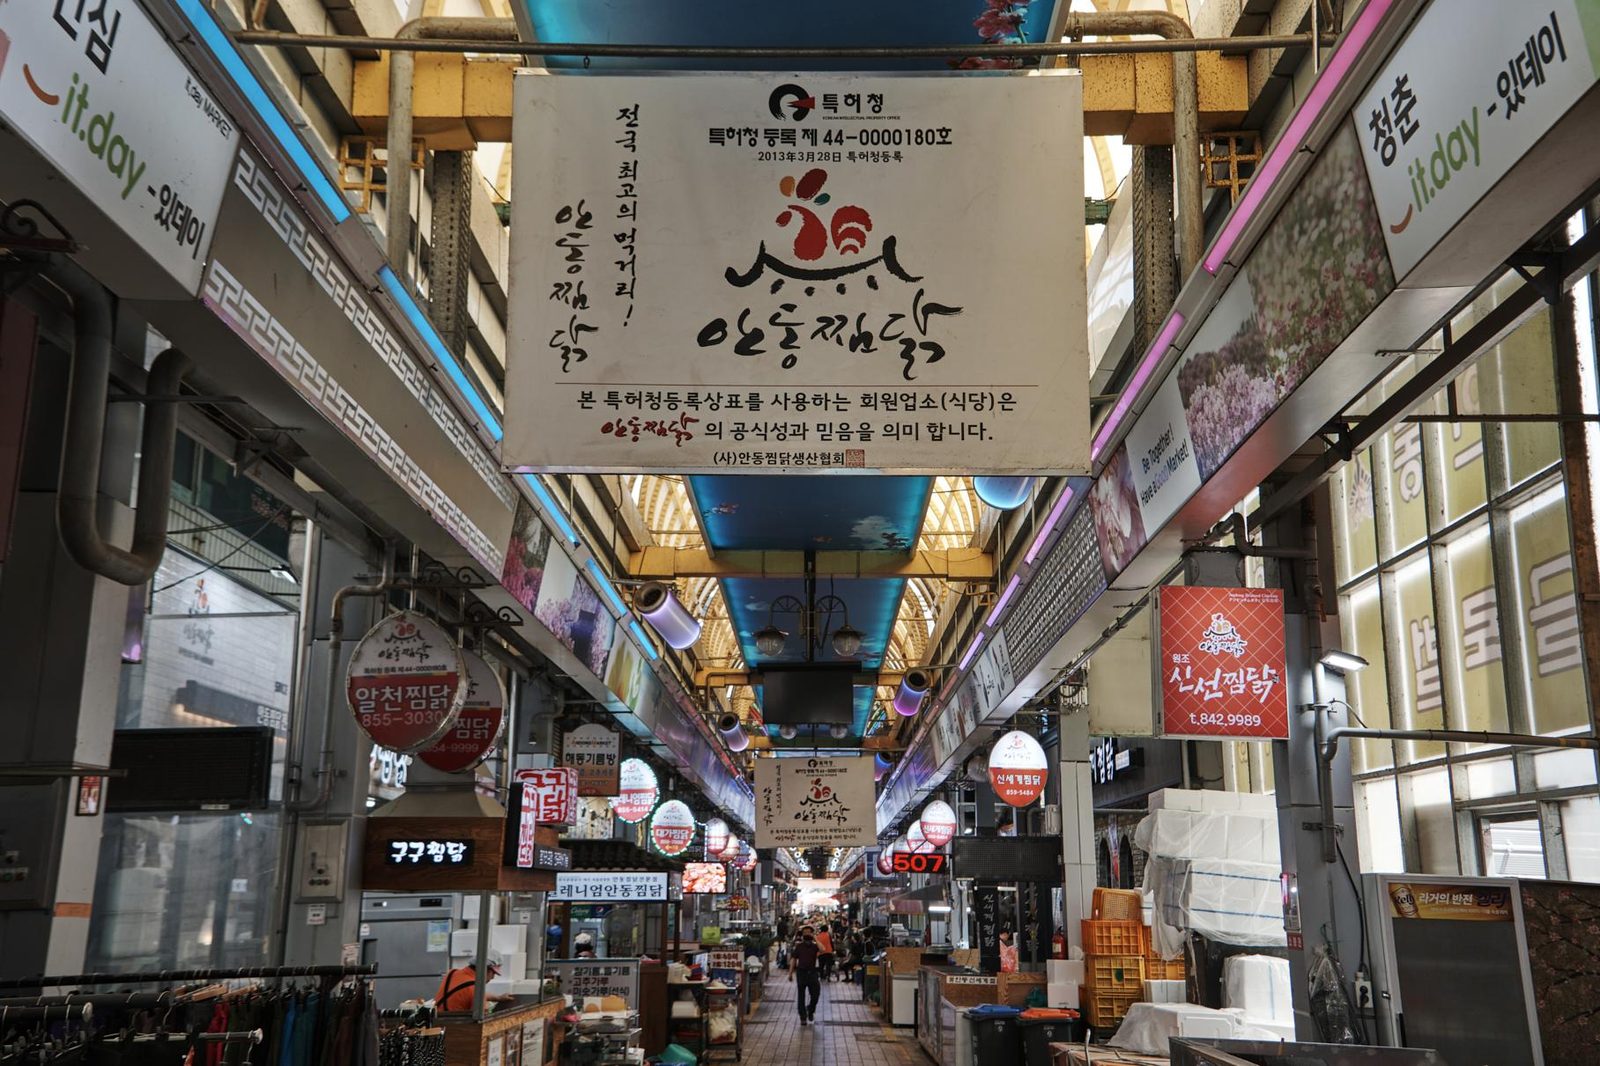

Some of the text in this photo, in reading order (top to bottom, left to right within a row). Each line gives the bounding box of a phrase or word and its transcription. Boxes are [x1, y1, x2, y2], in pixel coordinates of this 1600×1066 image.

[822, 93, 884, 114] 특허청
[615, 103, 639, 153] 전국
[1369, 73, 1420, 167] 청춘
[62, 72, 146, 200] it.day
[708, 126, 952, 147] 특허청 등록 제 44-0000180호
[758, 150, 903, 163] 2013年3月28日 특허청등록
[1408, 106, 1480, 212] it.day
[615, 160, 638, 221] 최고의
[697, 288, 964, 380] 안동찜닭
[577, 390, 1017, 413] 본 특허청등록상표를 사용하는 회원업소(식당)은
[705, 421, 723, 441] 의
[730, 421, 809, 441] 공식성과
[816, 421, 875, 441] 믿음을
[882, 421, 920, 441] 의미
[926, 421, 993, 441] 합니다.
[713, 451, 845, 467] (사)안동찜닭생산협회
[1169, 663, 1277, 703] 신선찜닭
[355, 685, 451, 713] 알천찜닭
[362, 711, 443, 727] 855-3030
[894, 854, 944, 873] 507
[1419, 892, 1450, 905] 라거의
[1452, 892, 1474, 905] 반전
